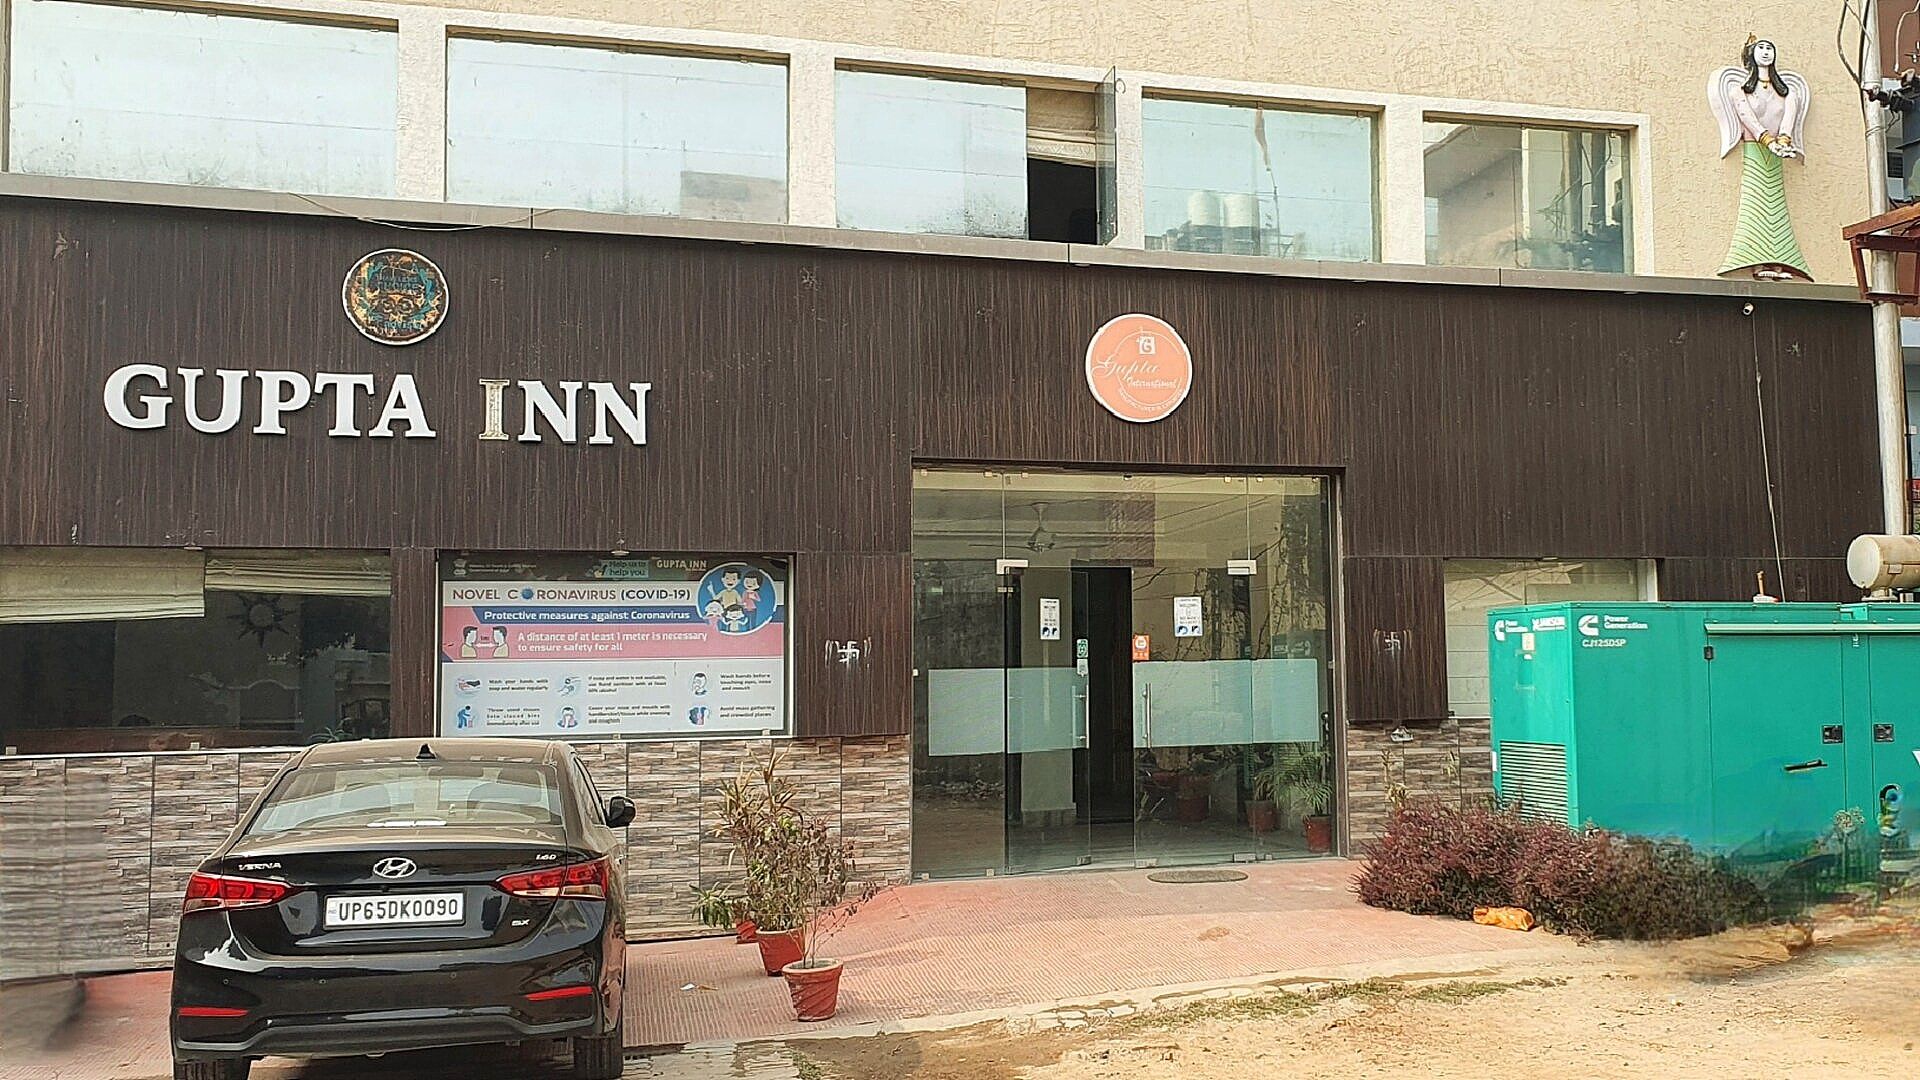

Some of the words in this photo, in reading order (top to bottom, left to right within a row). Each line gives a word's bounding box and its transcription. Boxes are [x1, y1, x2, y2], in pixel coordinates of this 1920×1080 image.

[1091, 357, 1158, 379] Gupta
[103, 363, 437, 438] GUPTA
[479, 378, 652, 446] INN
[656, 560, 686, 569] GUPTA
[689, 560, 707, 569] INN
[609, 568, 629, 577] help
[630, 569, 645, 577] you
[453, 589, 500, 600] NOVEL
[620, 589, 691, 601] (COVID-19)
[484, 611, 537, 620] Protective
[539, 611, 589, 620] measures
[591, 610, 628, 622] against
[631, 610, 690, 620] Coronavirus
[1603, 614, 1629, 622] Power
[518, 632, 524, 641] A
[527, 632, 566, 642] distance
[567, 632, 578, 641] of
[580, 633, 590, 641] at
[591, 632, 614, 641] least
[622, 632, 650, 641] meter
[652, 632, 661, 640] is
[662, 632, 707, 642] necessary
[518, 643, 527, 652] to
[529, 644, 561, 652] ensure
[563, 643, 593, 653] safety
[595, 642, 609, 651] for
[611, 642, 623, 651] all
[339, 899, 458, 921] UP65DK0090
